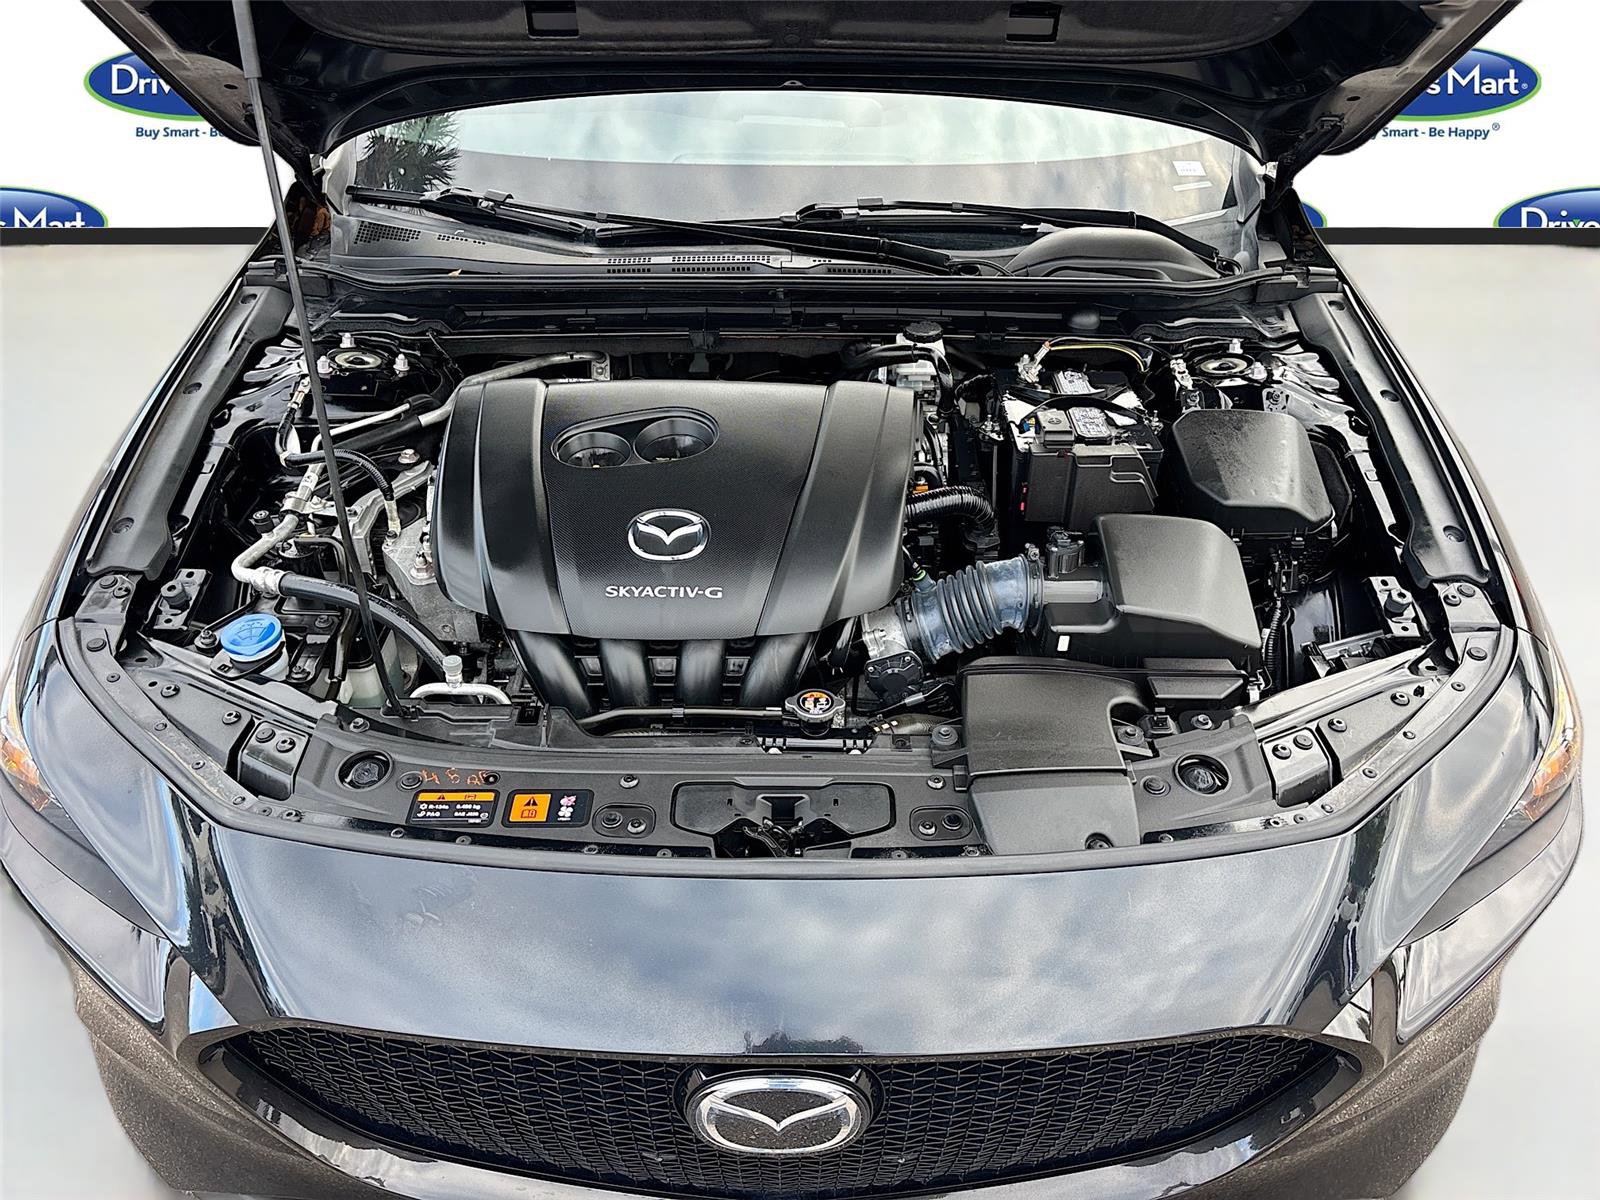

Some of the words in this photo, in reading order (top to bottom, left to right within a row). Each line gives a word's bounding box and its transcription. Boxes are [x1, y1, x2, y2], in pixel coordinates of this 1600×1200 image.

[135, 127, 160, 139] Buy
[163, 126, 200, 137] Smart
[1382, 127, 1419, 138] Smart
[1428, 127, 1445, 138] Be
[1448, 127, 1490, 140] Happy
[605, 585, 723, 599] SKYACTIV-G
